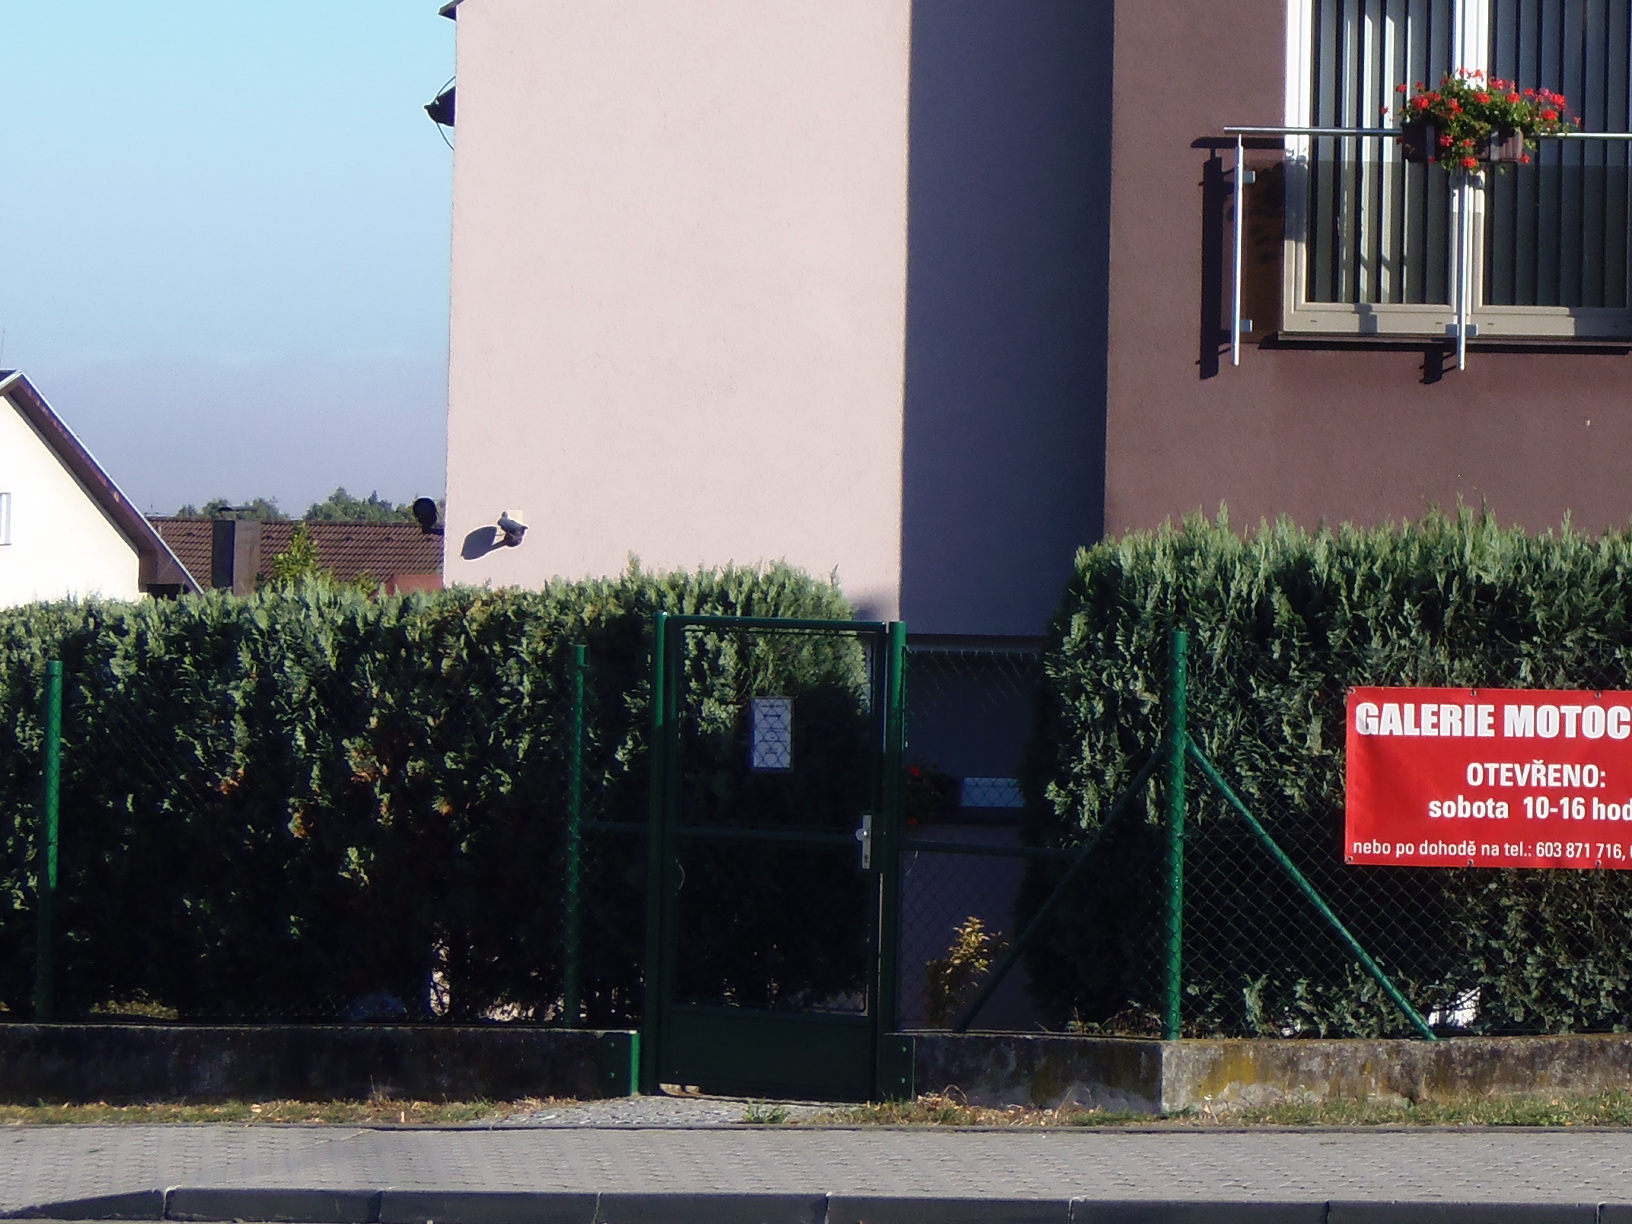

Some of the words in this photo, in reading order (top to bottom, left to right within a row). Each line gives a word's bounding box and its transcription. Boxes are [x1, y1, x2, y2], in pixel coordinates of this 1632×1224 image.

[1355, 702, 1495, 737] GALERIE
[1467, 760, 1606, 788] OTEVŘENO:
[1429, 795, 1509, 819] sobota
[1523, 797, 1585, 820] 10-16
[1353, 839, 1391, 855] nebo
[1395, 843, 1414, 857] po
[1419, 840, 1477, 856] dohodě
[1482, 845, 1500, 857] na
[1504, 842, 1532, 857] tel.:
[1536, 843, 1562, 858] 603
[1566, 843, 1591, 858] 871
[1596, 844, 1626, 861] 716,
